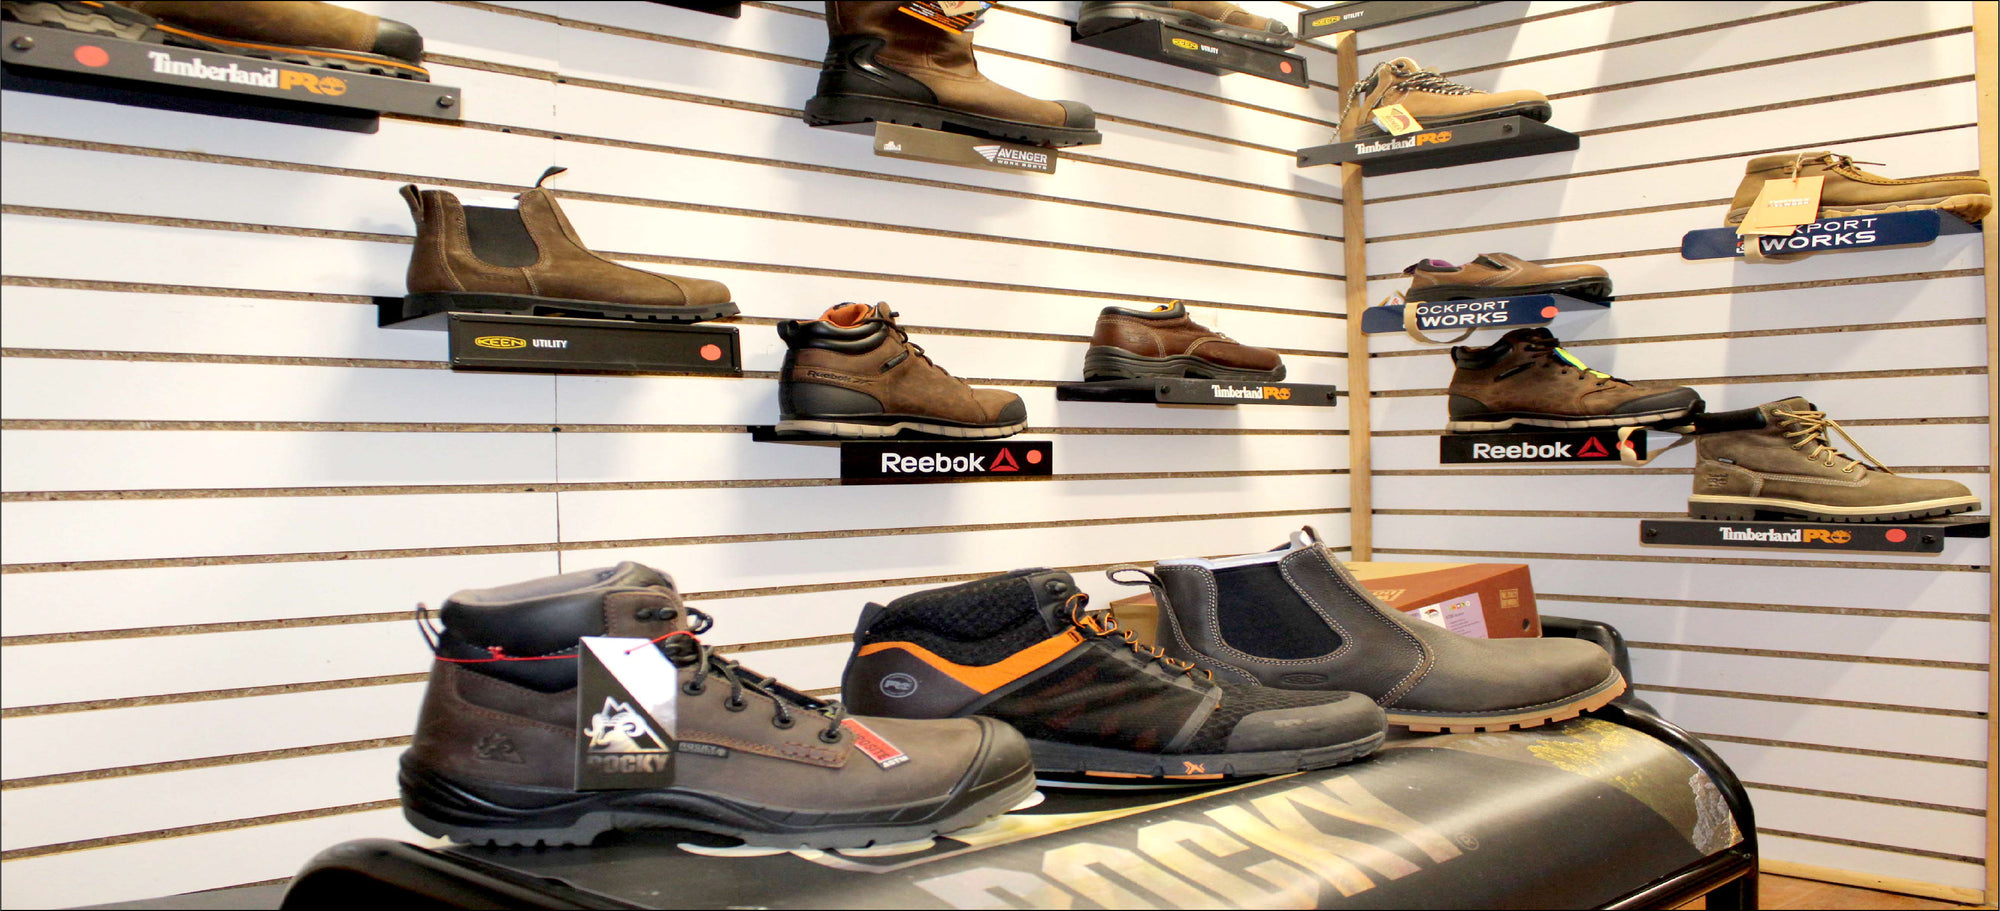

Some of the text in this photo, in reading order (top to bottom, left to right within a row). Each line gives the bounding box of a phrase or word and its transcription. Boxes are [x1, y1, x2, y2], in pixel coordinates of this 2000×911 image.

[1343, 11, 1364, 20] UTILITY
[997, 148, 1047, 163] AVENGER
[1794, 217, 1877, 234] KPORT
[1761, 230, 1876, 251] WORKS
[1416, 301, 1509, 315] OCKPORT
[1421, 311, 1509, 328] WORKS
[475, 337, 568, 349] KEEN UTILITY
[1473, 441, 1573, 459] Reebok
[881, 452, 985, 473] Reebok
